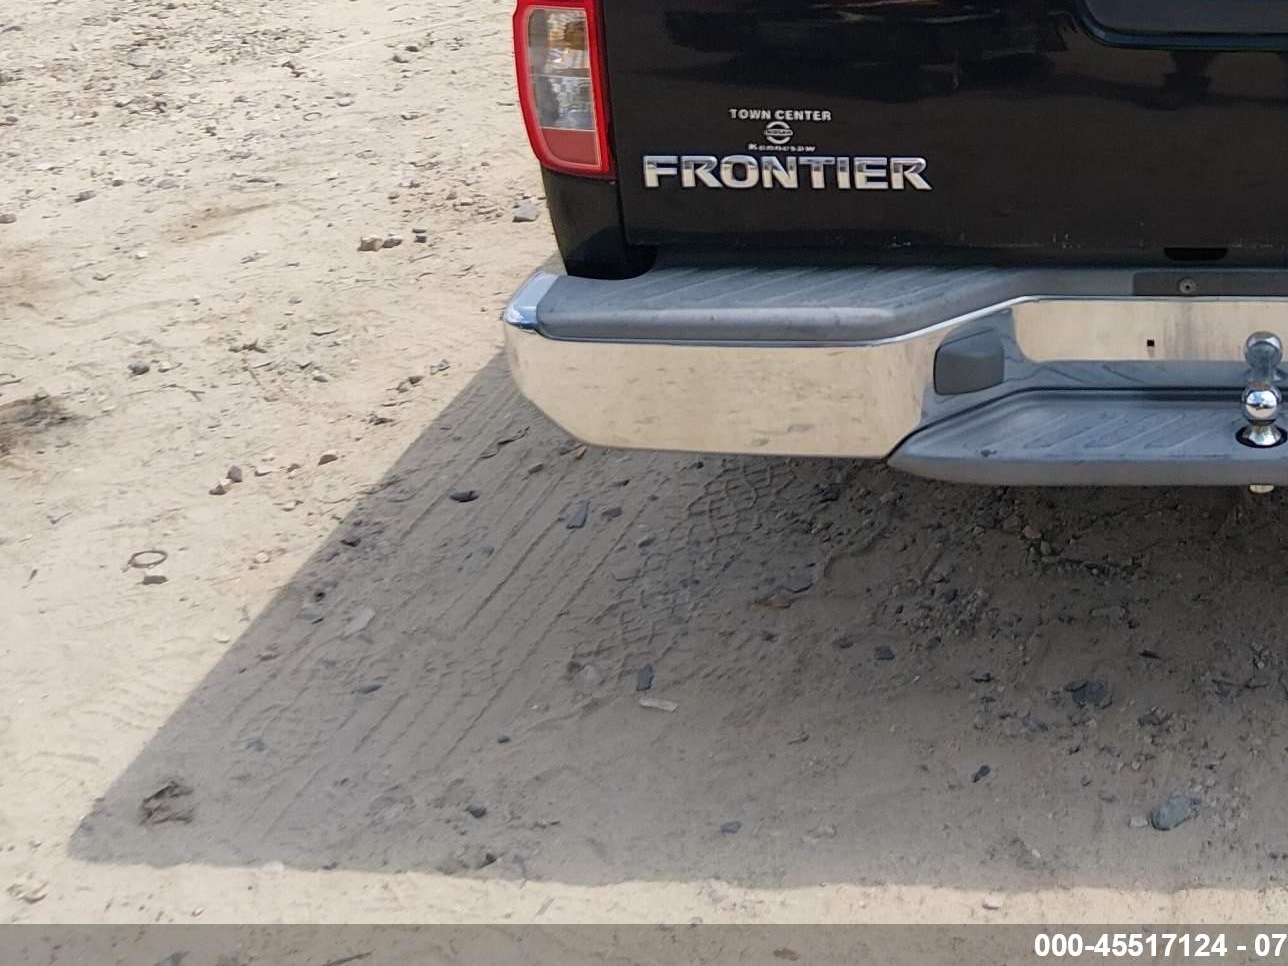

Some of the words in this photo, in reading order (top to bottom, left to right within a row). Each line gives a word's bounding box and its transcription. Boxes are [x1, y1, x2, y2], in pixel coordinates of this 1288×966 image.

[729, 108, 772, 120] TOWN
[774, 109, 832, 122] CENTER
[643, 154, 932, 190] FRONTIER
